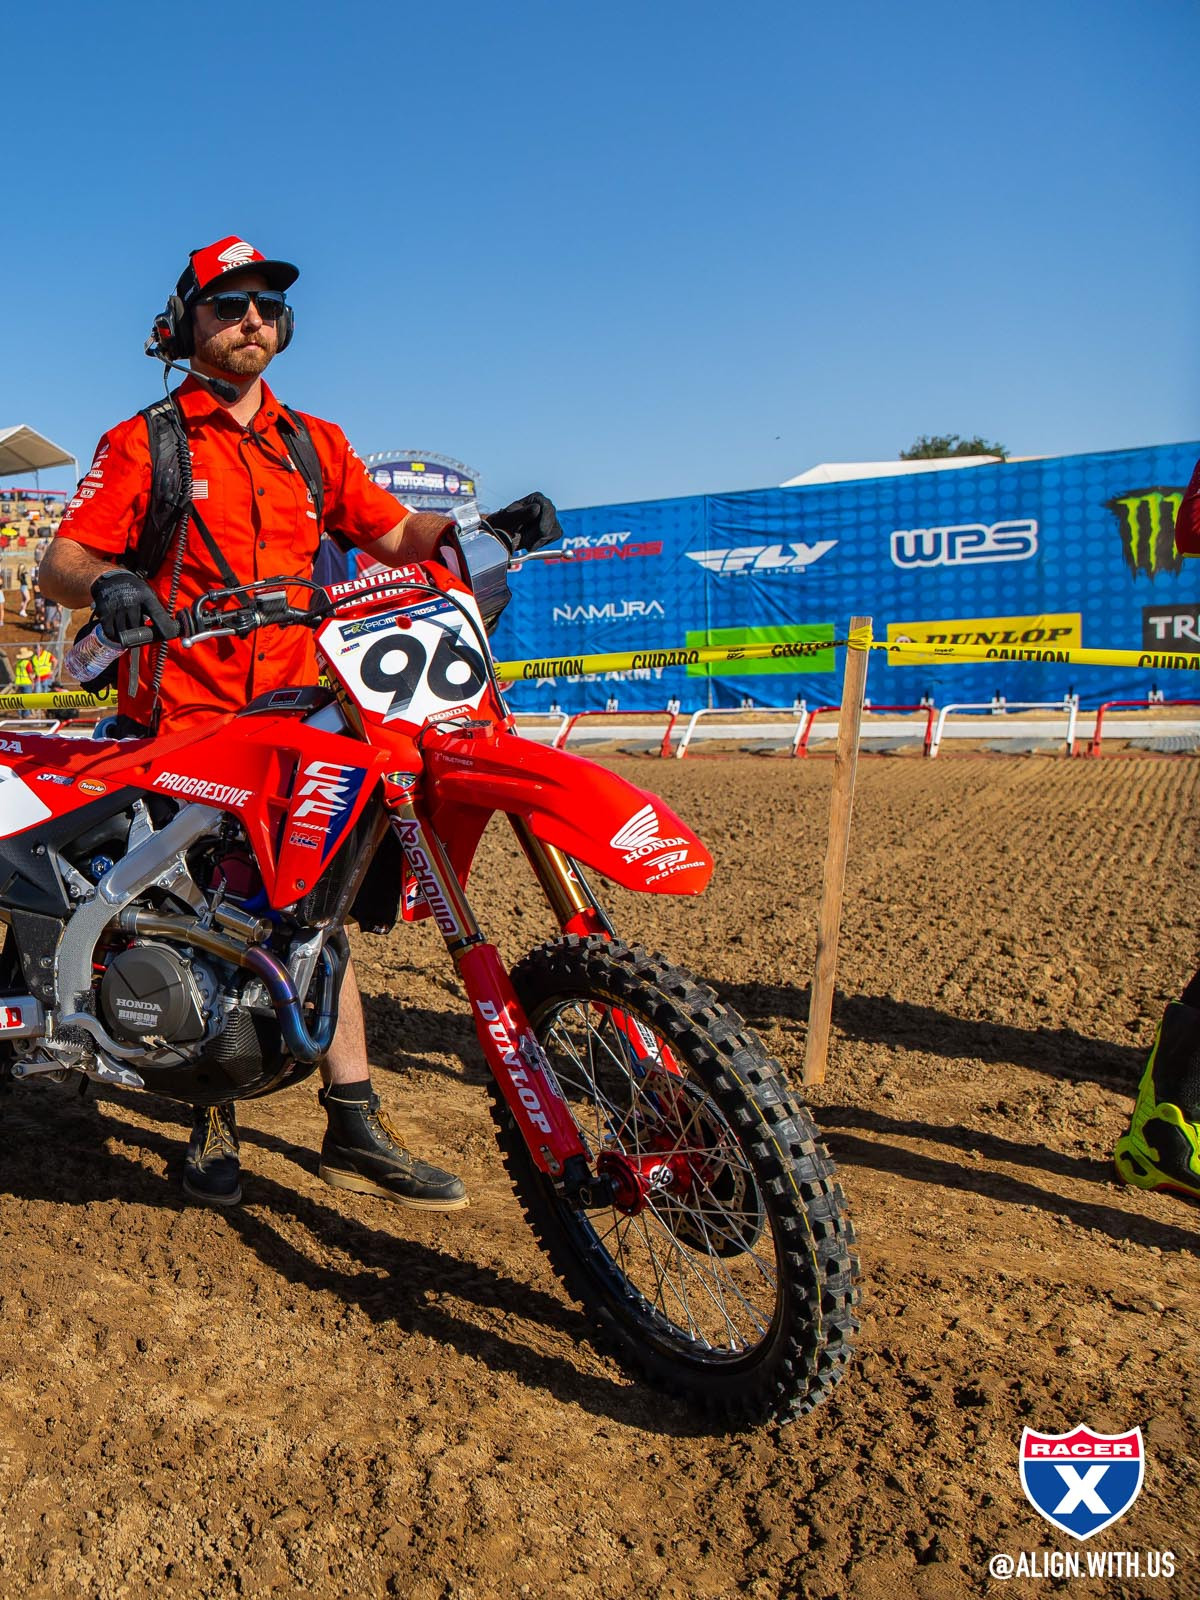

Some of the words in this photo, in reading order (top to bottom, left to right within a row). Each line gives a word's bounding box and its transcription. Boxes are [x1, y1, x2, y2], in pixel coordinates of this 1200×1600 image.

[221, 258, 257, 272] HON
[562, 532, 632, 549] MX-ATV
[892, 520, 1037, 567] WPS
[718, 540, 839, 571] FLY
[332, 567, 415, 596] RENTHAL
[719, 567, 806, 578] RACING
[553, 599, 665, 621] NAMURA
[926, 628, 1072, 645] DUNLOP
[1149, 615, 1200, 642] TR
[522, 659, 584, 680] CAUTION
[632, 650, 699, 670] CUIDADO
[985, 648, 1070, 663] CAUTION
[361, 624, 486, 724] 96
[53, 694, 95, 708] CUIDADO
[429, 707, 470, 721] HONDA
[152, 771, 253, 807] PROGRESSIVE
[293, 760, 356, 817] CRF
[622, 837, 690, 864] HONDA
[645, 871, 669, 885] Pro
[669, 861, 705, 873] Honda
[407, 848, 459, 935] SHOWA
[116, 998, 162, 1012] HONDA
[476, 1000, 552, 1133] DUNLOP
